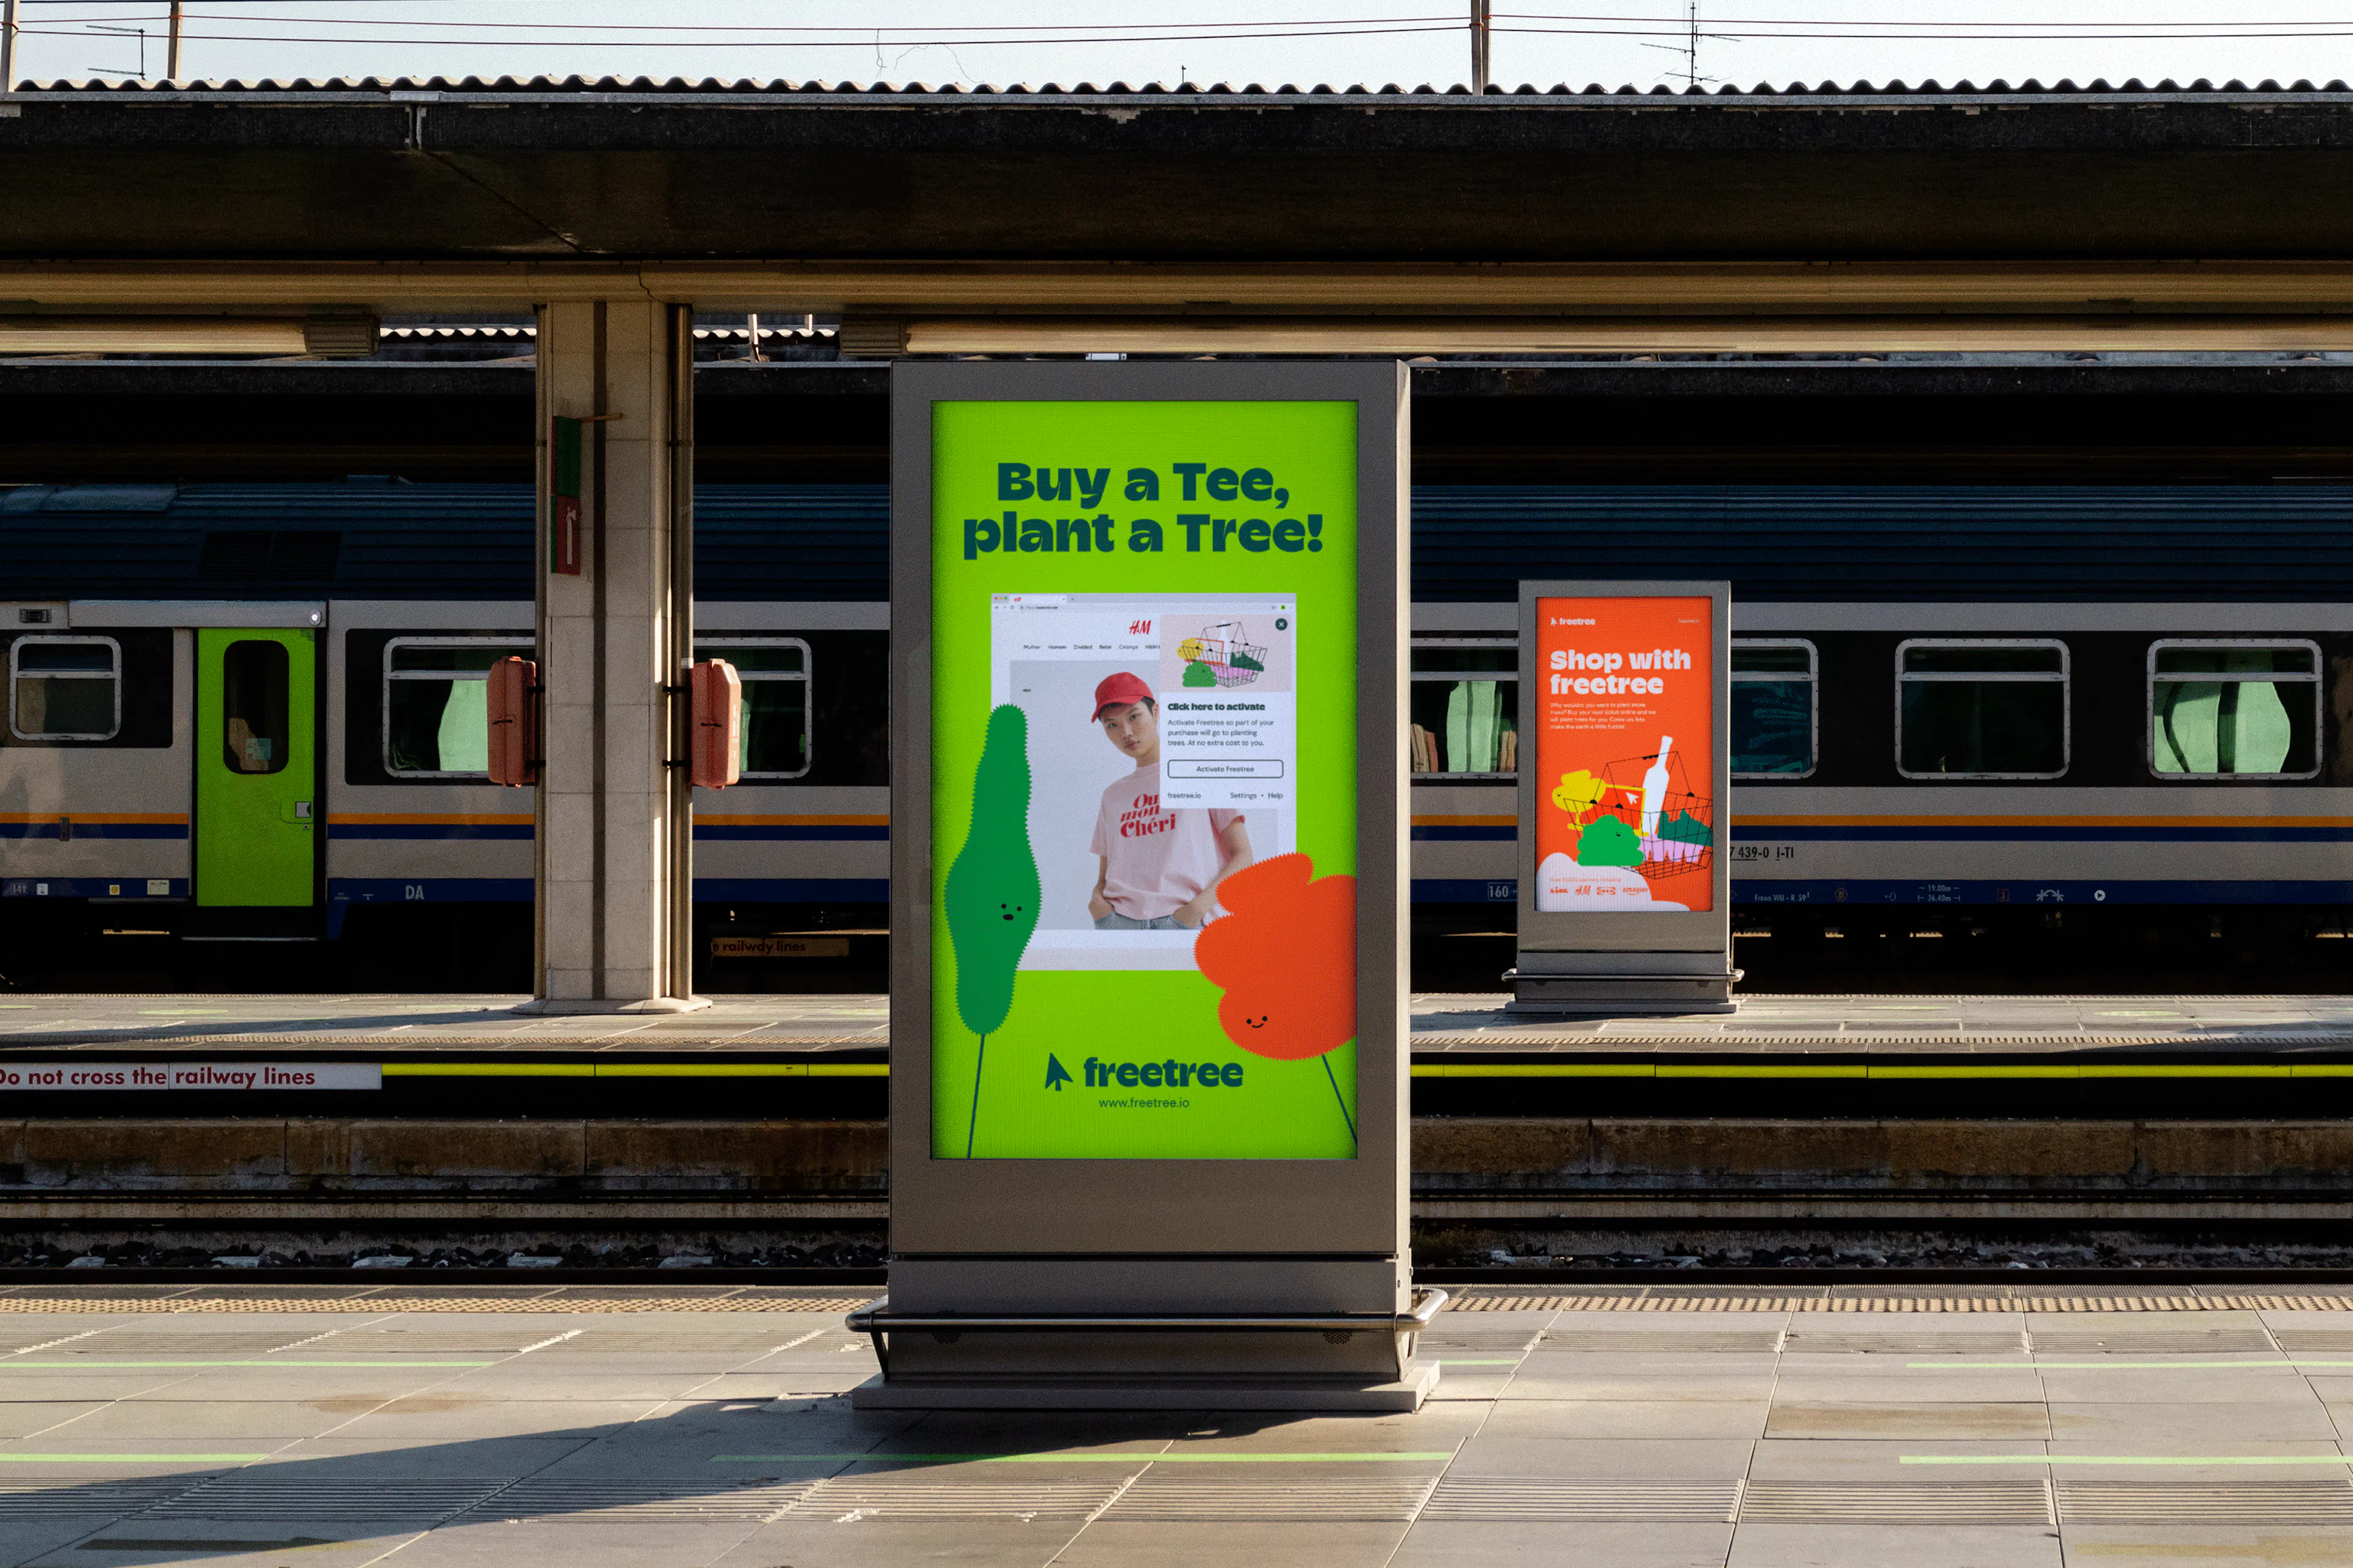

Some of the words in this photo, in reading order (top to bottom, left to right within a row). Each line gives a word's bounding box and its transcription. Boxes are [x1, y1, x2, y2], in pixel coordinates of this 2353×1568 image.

[998, 463, 1110, 509] Buy
[1124, 468, 1159, 501] a
[1173, 463, 1289, 509] Tee,
[964, 511, 1114, 560] plant
[1128, 519, 1163, 552] a
[1177, 514, 1322, 552] Tree!
[1550, 650, 1623, 673] Shop
[1629, 649, 1691, 670] with
[1550, 674, 1663, 694] freetree
[1120, 805, 1160, 822] mon
[1120, 813, 1175, 838] Chéri
[1738, 847, 1769, 858] 439-0
[405, 885, 424, 900] DA
[1490, 885, 1509, 898] 160
[723, 941, 773, 953] railway
[776, 941, 806, 951] lines
[29, 1070, 63, 1085] not
[70, 1071, 125, 1085] cross
[132, 1067, 167, 1085] the
[176, 1067, 257, 1089] railway
[264, 1067, 316, 1085] lines
[1083, 1057, 1243, 1087] freetree
[1099, 1098, 1189, 1108] www.freetree.io
